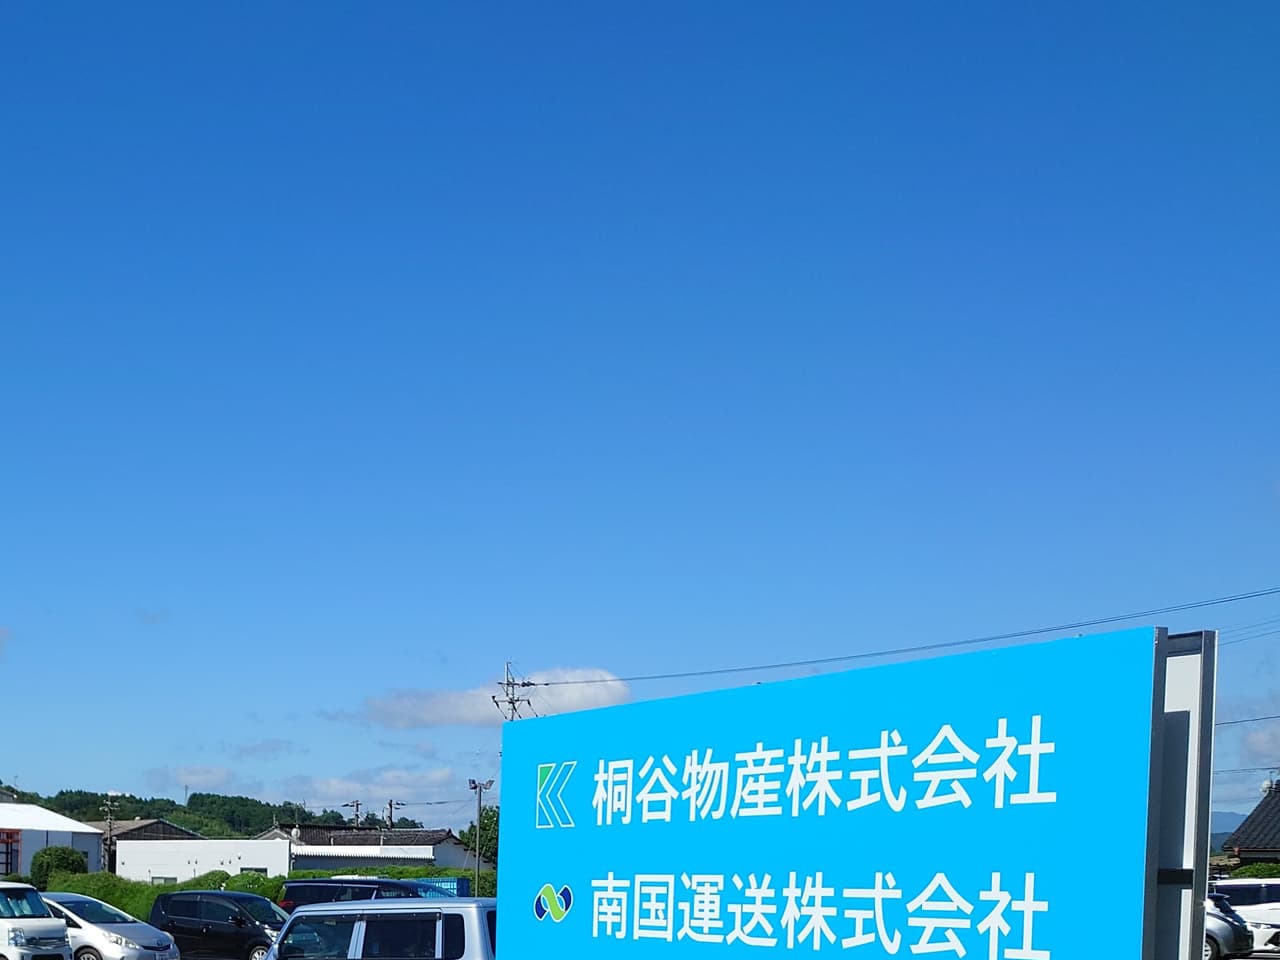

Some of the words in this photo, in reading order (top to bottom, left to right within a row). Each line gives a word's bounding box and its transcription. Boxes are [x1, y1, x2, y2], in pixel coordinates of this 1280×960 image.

[592, 714, 1057, 827] 桐谷物産株式会社
